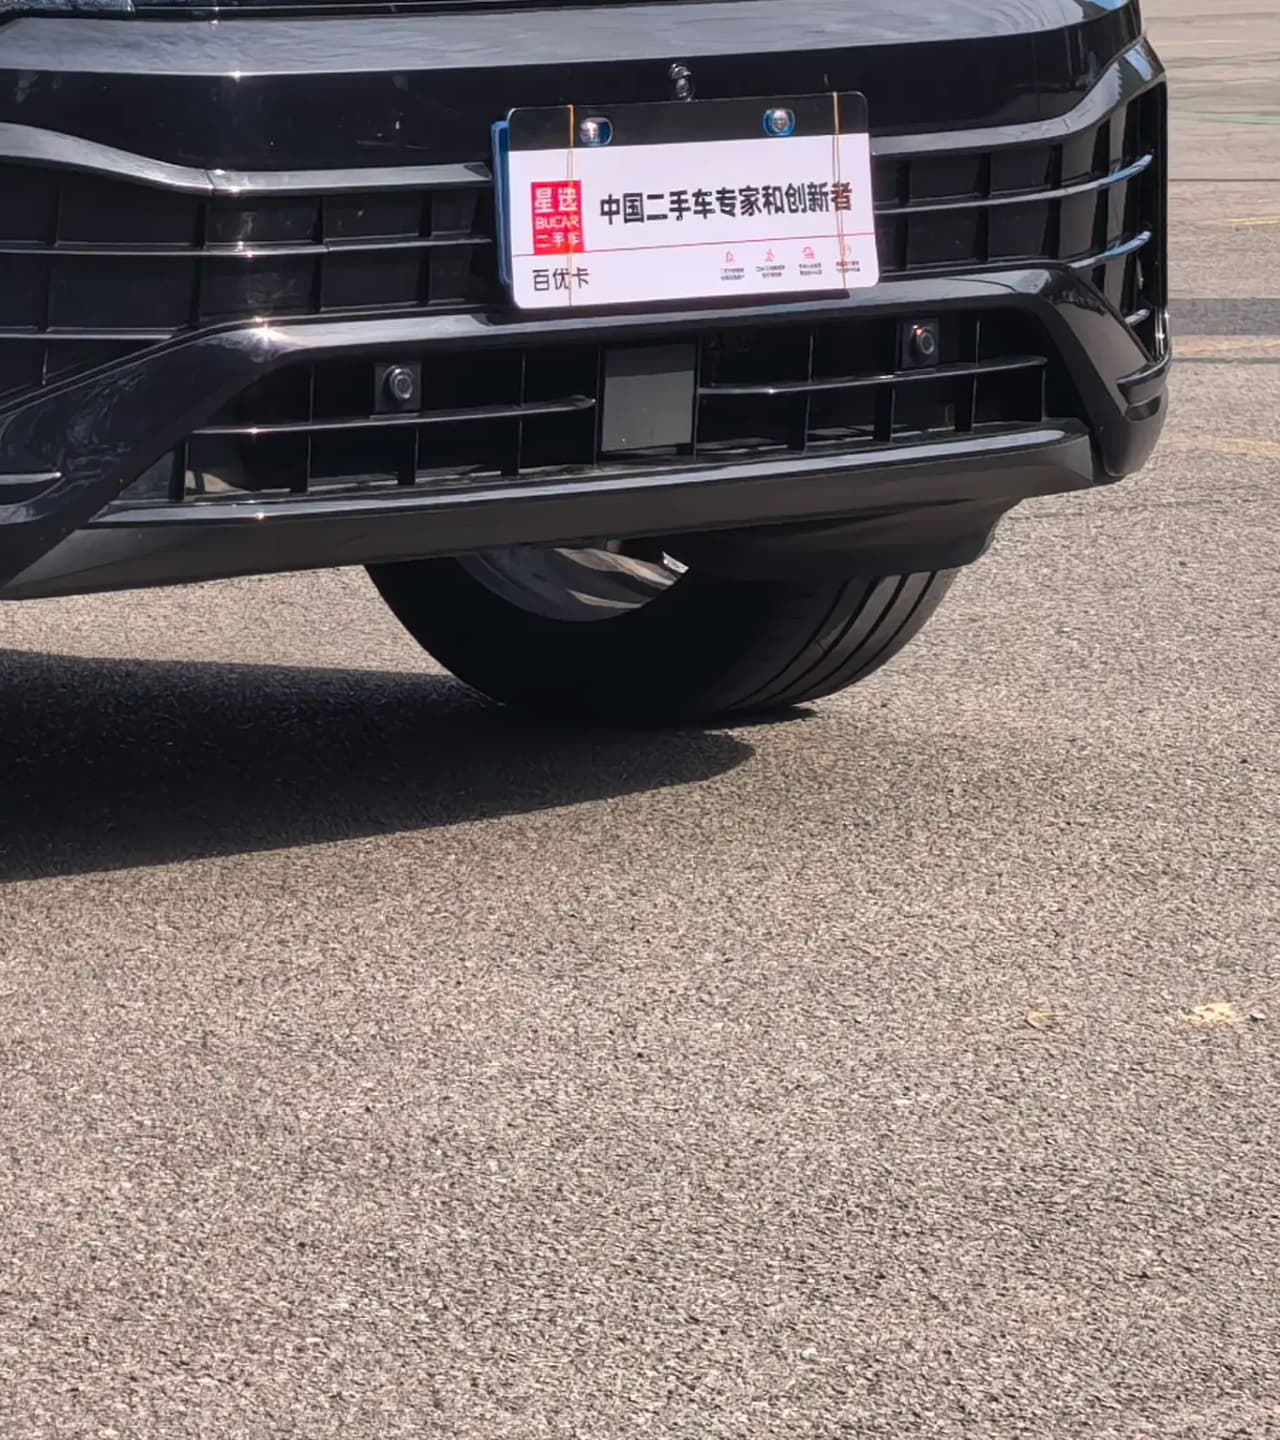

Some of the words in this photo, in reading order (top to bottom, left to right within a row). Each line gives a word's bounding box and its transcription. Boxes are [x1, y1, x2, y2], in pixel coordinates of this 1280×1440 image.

[535, 186, 578, 214] 星选
[599, 180, 853, 226] 中国二手车专家和创新者
[535, 215, 581, 230] BUCAR
[536, 231, 580, 249] 二手车
[532, 266, 590, 291] 百优卡
